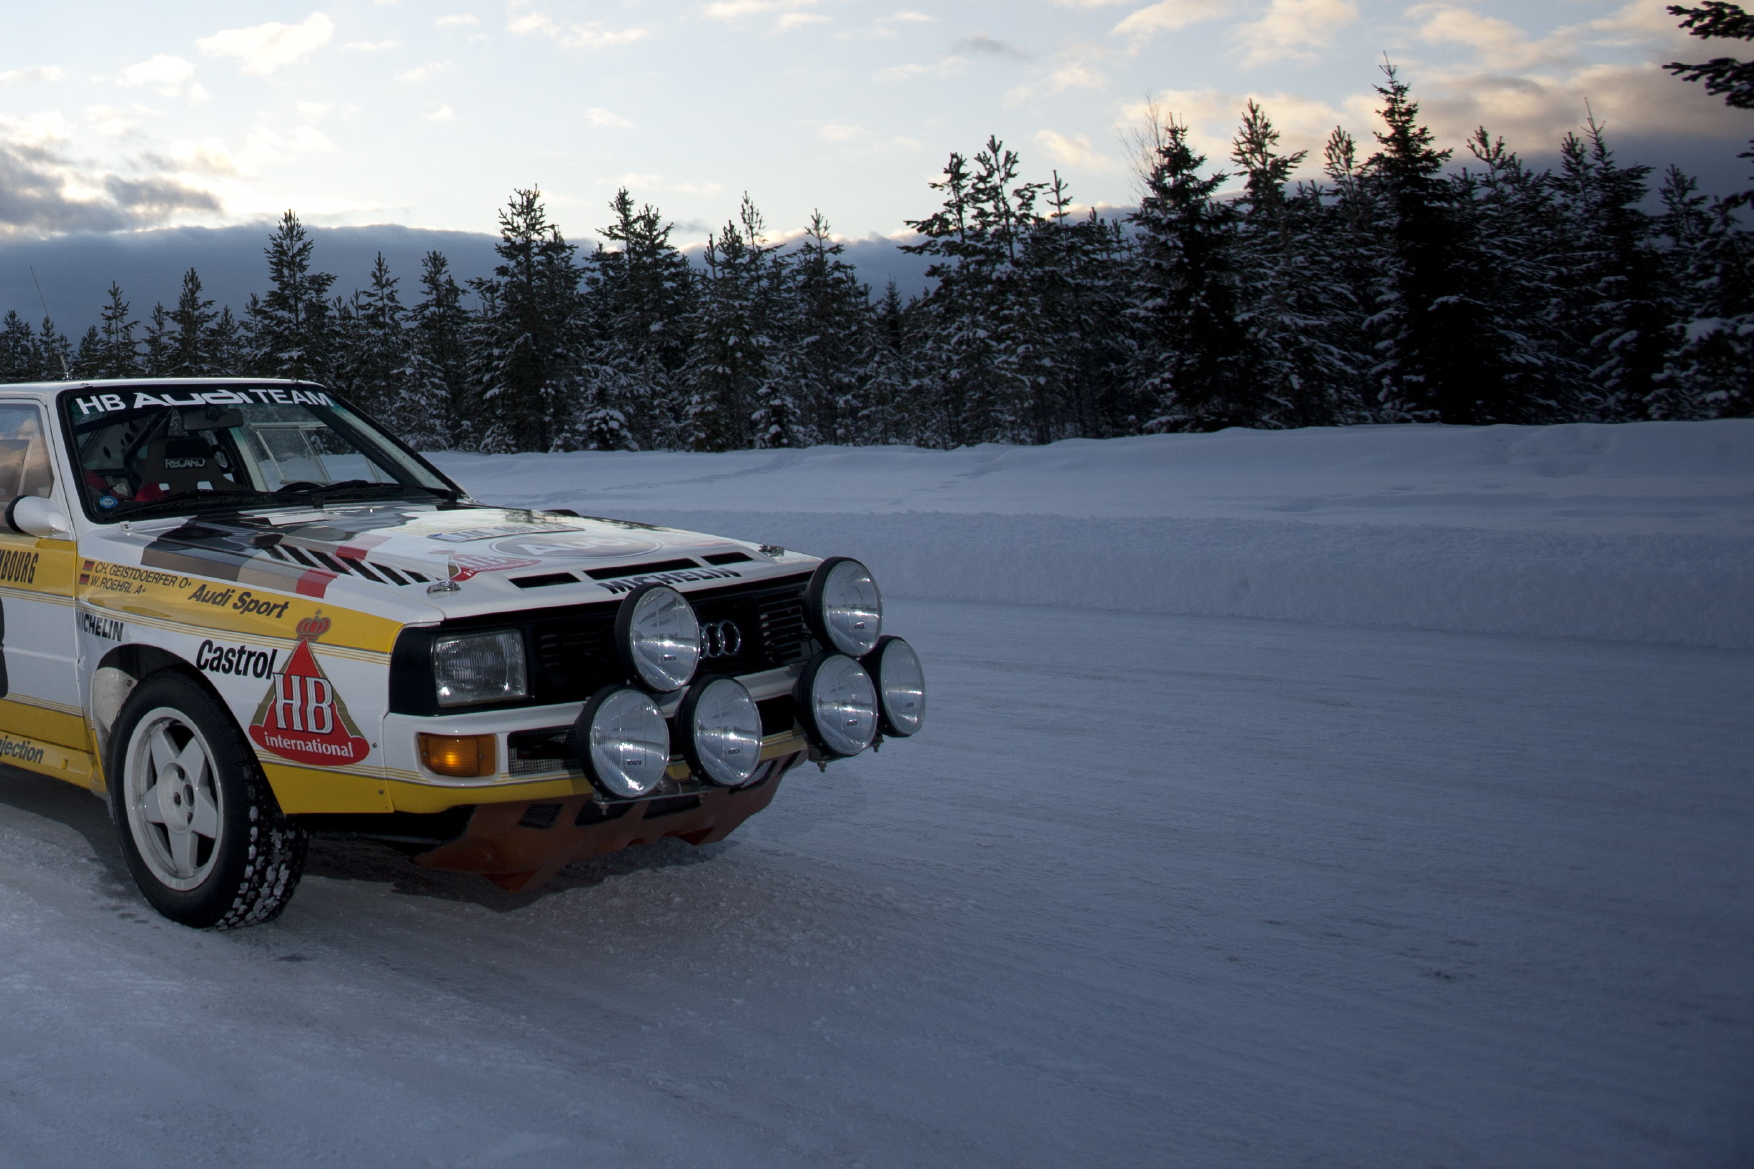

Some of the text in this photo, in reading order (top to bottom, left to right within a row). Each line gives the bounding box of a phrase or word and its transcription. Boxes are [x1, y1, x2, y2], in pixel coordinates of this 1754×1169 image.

[75, 393, 127, 415] HB
[247, 388, 336, 408] TEAM
[164, 456, 206, 470] RECARO
[109, 564, 178, 589] GEISTDOERFER
[595, 567, 743, 595] MICHELIN
[187, 583, 290, 619] Audi Sport
[196, 639, 279, 681] Castrol
[272, 672, 335, 735] HB
[263, 731, 355, 759] international
